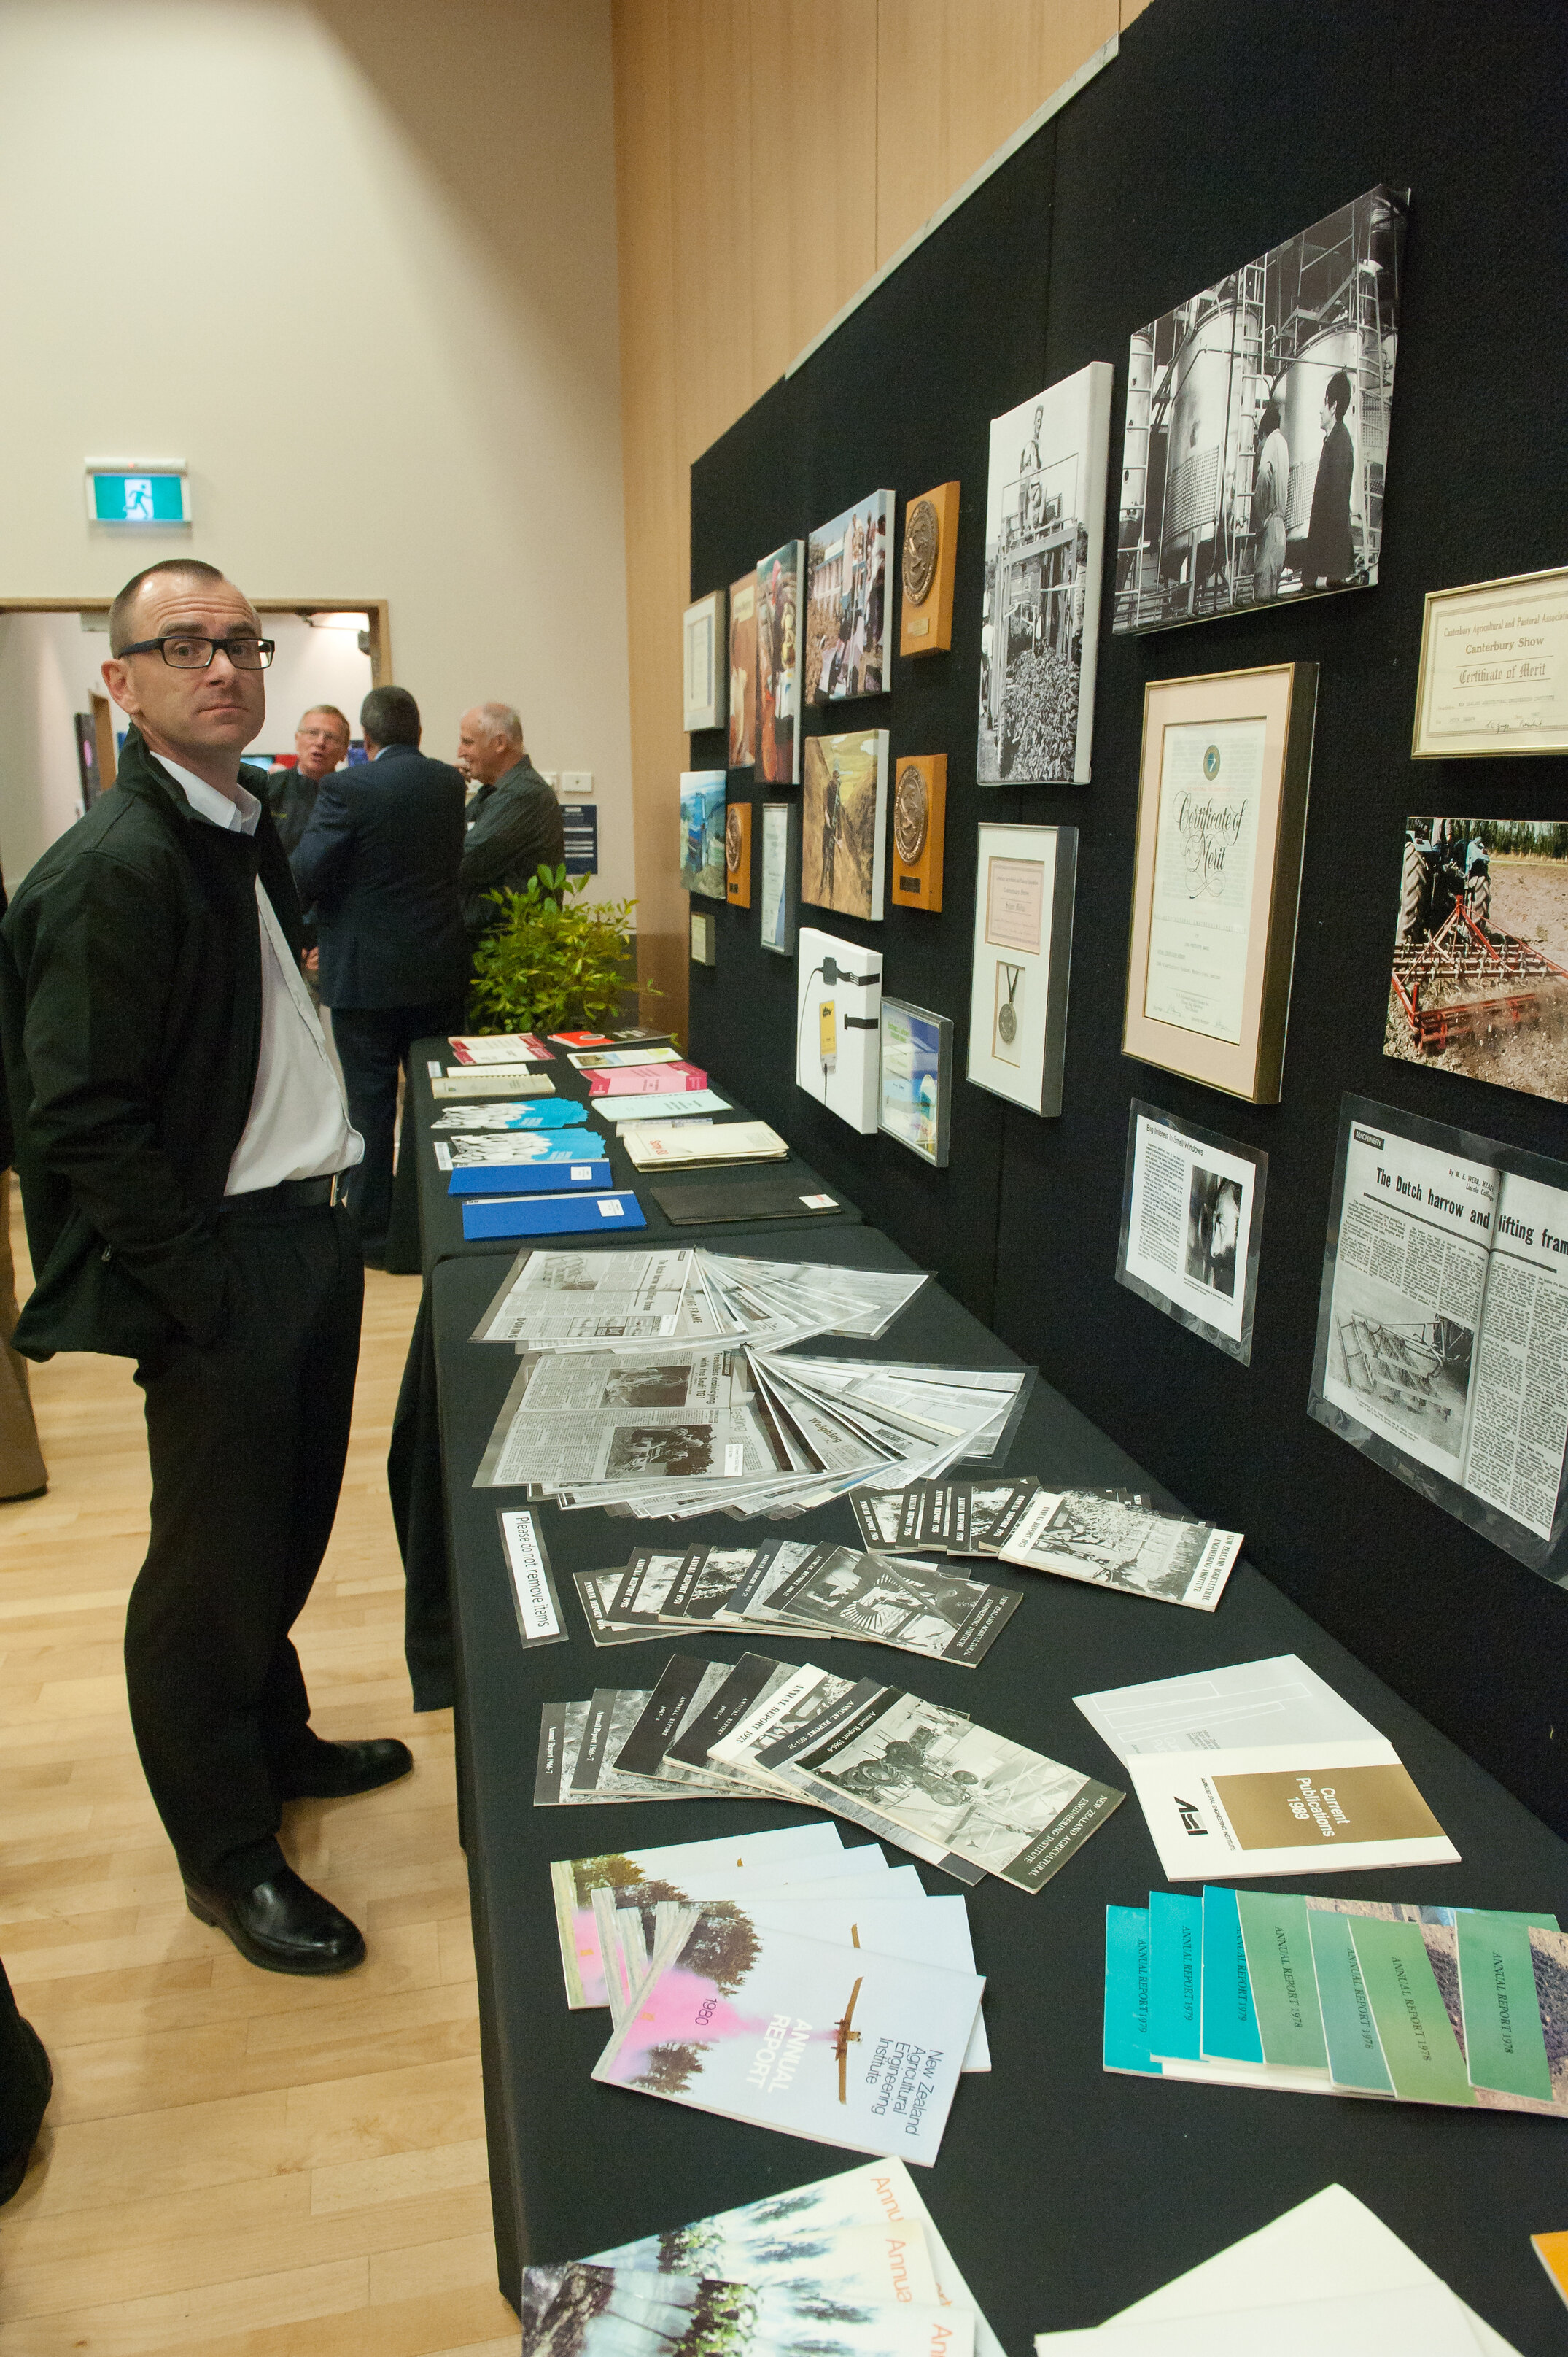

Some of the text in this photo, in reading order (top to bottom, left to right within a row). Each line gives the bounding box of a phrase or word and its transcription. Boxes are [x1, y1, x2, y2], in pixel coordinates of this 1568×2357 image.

[1444, 626, 1472, 637] Canterbury
[1472, 620, 1503, 633] Agricultural
[1505, 618, 1515, 628] and
[1517, 616, 1540, 627] Pastoral
[1466, 636, 1545, 654] Canterbury Show
[1459, 662, 1546, 684] Certificate of Merit
[1173, 791, 1232, 840] Certificate
[1154, 1127, 1168, 1139] Interest
[1173, 1135, 1184, 1147] Small
[1184, 1140, 1203, 1156] Windows
[1356, 1131, 1383, 1147] MACHINERY
[1376, 1166, 1568, 1255] The Dutch harrow and lifting fram
[688, 1307, 703, 1323] FRAME
[699, 1356, 710, 1368] with
[699, 1368, 709, 1377] the
[706, 1377, 721, 1404] drainlaying
[731, 1407, 748, 1432] Testing
[808, 1417, 843, 1444] Weighing
[864, 1516, 876, 1531] REPORT
[905, 1510, 915, 1527] REPORT
[932, 1507, 942, 1524] REPORT
[956, 1513, 965, 1531] REPORT
[1000, 1510, 1016, 1529] REPORT
[1036, 1506, 1051, 1522] ANNUAL
[1025, 1522, 1041, 1539] REPORT
[515, 1517, 549, 1628] Please do not remove items
[632, 1557, 646, 1576] ANNUAL
[686, 1555, 701, 1574] ANNUAL
[748, 1569, 762, 1585] REPORT
[1193, 1539, 1222, 1592] ENGINEERING INSTITUTE
[1201, 1534, 1235, 1601] NEW ZEALAND AGRICULTURAL
[583, 1581, 597, 1600] ANNUAL
[624, 1576, 640, 1597] REPORT
[678, 1574, 694, 1594] REPORT
[793, 1571, 810, 1586] REPORT
[589, 1599, 603, 1618] REPORT
[956, 1598, 994, 1648] ENGINEERING INSTITUTE
[963, 1595, 1009, 1656] NEW ZEALAND AGRICULTURAL
[594, 1710, 605, 1728] Annual
[661, 1695, 686, 1736] ANNUAL REPORT
[716, 1697, 749, 1736] ANNUAL REPORT
[736, 1683, 804, 1743] ANNUAL REPORT 1973
[829, 1700, 855, 1722] ANNUAL
[858, 1711, 876, 1728] Annual
[548, 1725, 557, 1741] Annual
[591, 1728, 602, 1744] Report
[807, 1719, 832, 1738] REPORT
[842, 1724, 861, 1741] Report
[546, 1741, 556, 1759] Report
[1200, 1777, 1236, 1851] AGRICULTURAL ENGINEERING INSTITUTE
[1286, 1796, 1310, 1819] 1989
[1295, 1777, 1335, 1837] Publications
[1320, 1787, 1351, 1824] Current
[1023, 1797, 1090, 1864] ENGINEERING INSTITUTE
[1028, 1795, 1108, 1876] NEW ZEALAND AGRICULTURAL
[1138, 1939, 1148, 2033] ANNUAL REPORT 1979
[1182, 1925, 1194, 2021] ANNUAL REPORT 1979
[1237, 1965, 1248, 2002] REPORT
[1274, 1925, 1303, 2028] ANNUAL REPORT 1978
[694, 1998, 718, 2026] 1980
[1237, 2002, 1248, 2022] 1979
[1347, 1948, 1374, 2050] ANNUAL REPORT 1978
[1392, 1956, 1432, 2062] ANNUAL REPORT 1978
[1492, 1951, 1514, 2054] ANNUAL REPORT 1978
[745, 2013, 791, 2089] REPORT
[766, 2018, 813, 2094] ANNUAL
[865, 2037, 894, 2085] Institute
[871, 2041, 911, 2116] Engineering
[893, 2045, 926, 2116] Agricultural
[904, 2049, 944, 2137] New Zealand
[870, 2177, 905, 2223] Annu
[885, 2238, 913, 2304] Annua
